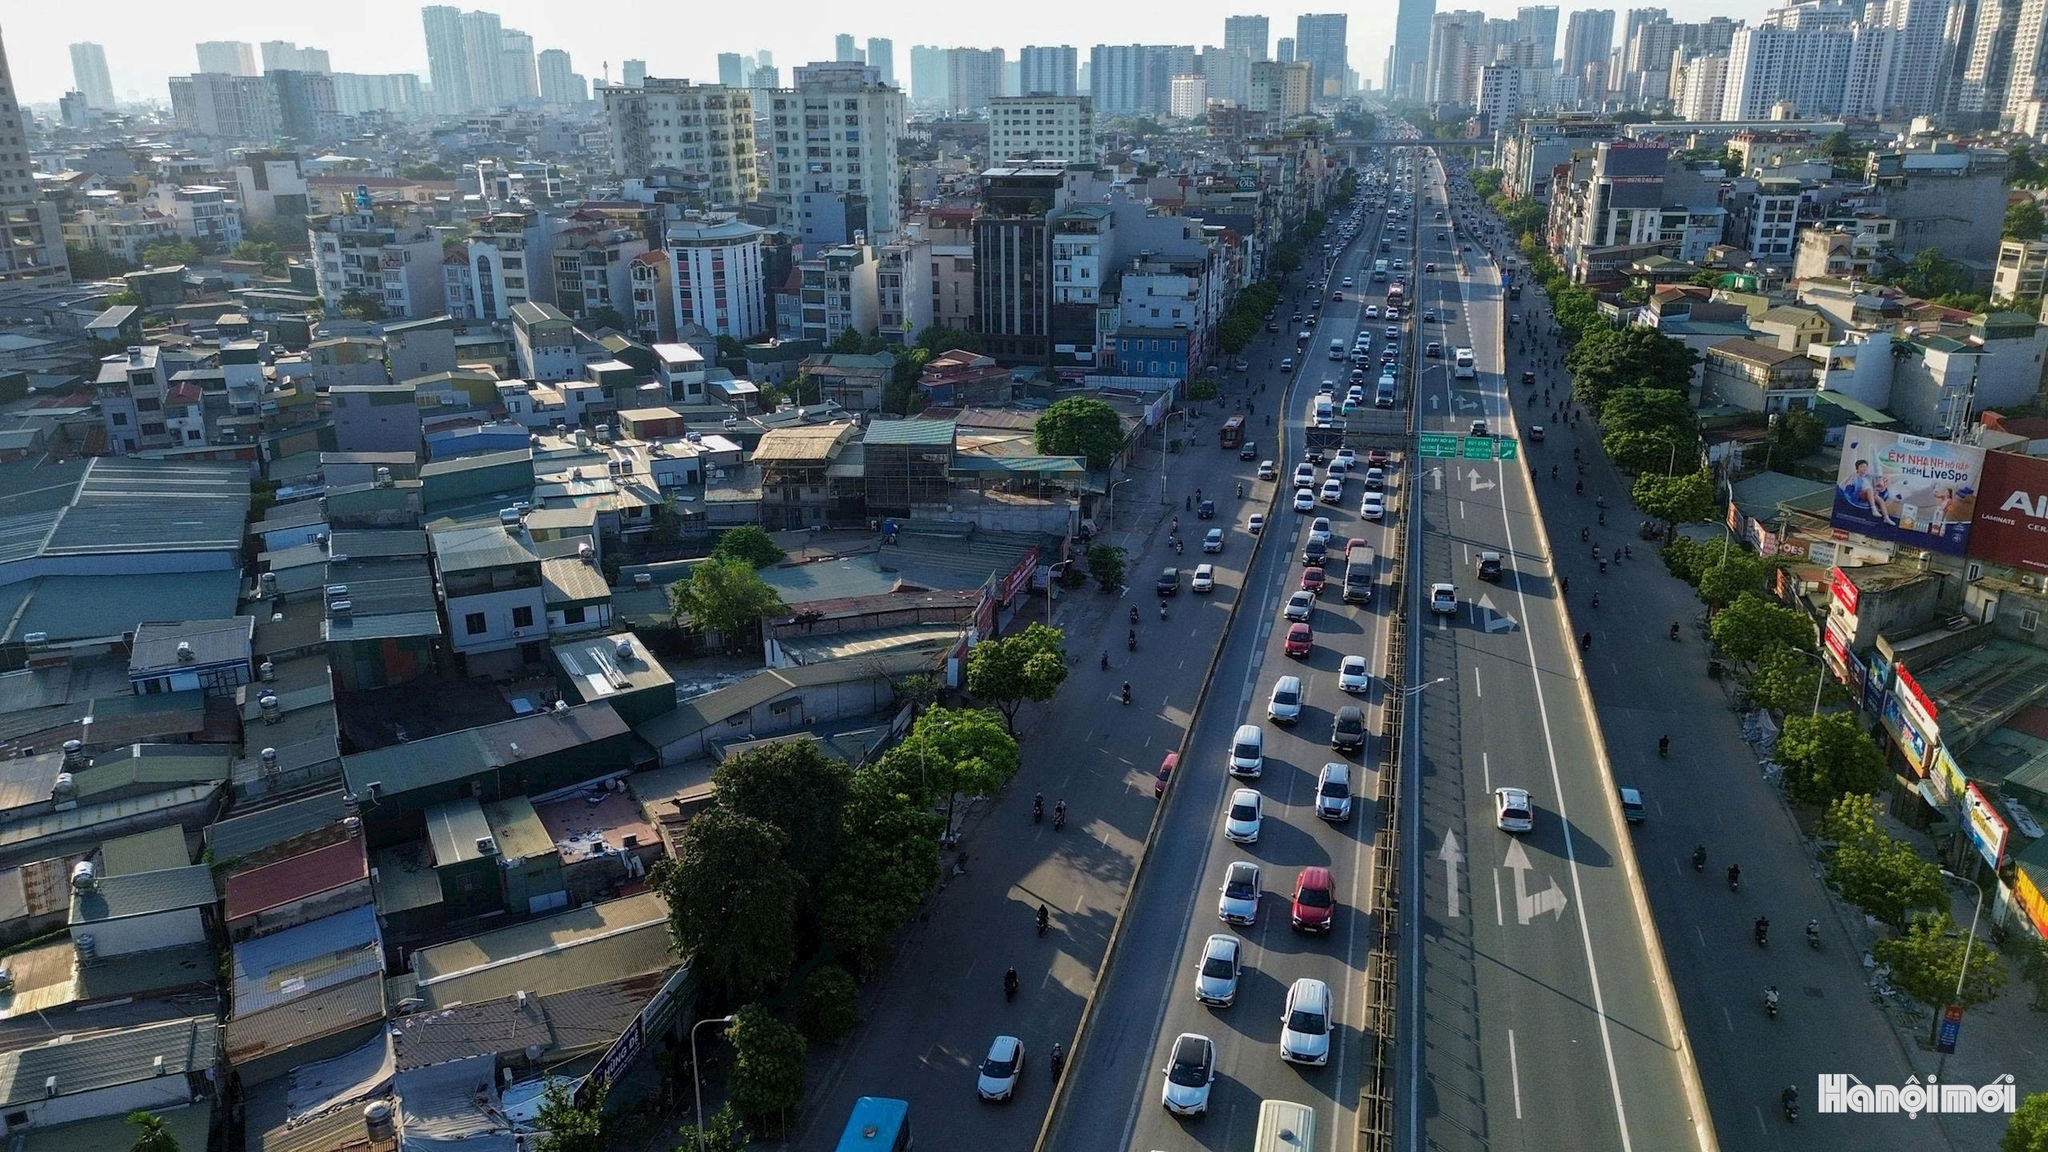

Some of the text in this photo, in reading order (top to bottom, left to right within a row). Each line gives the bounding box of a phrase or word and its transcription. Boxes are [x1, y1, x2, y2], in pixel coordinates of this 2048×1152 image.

[1901, 466, 1968, 482] THÊM LiveSpo
[1981, 513, 2015, 525] LAMINATE
